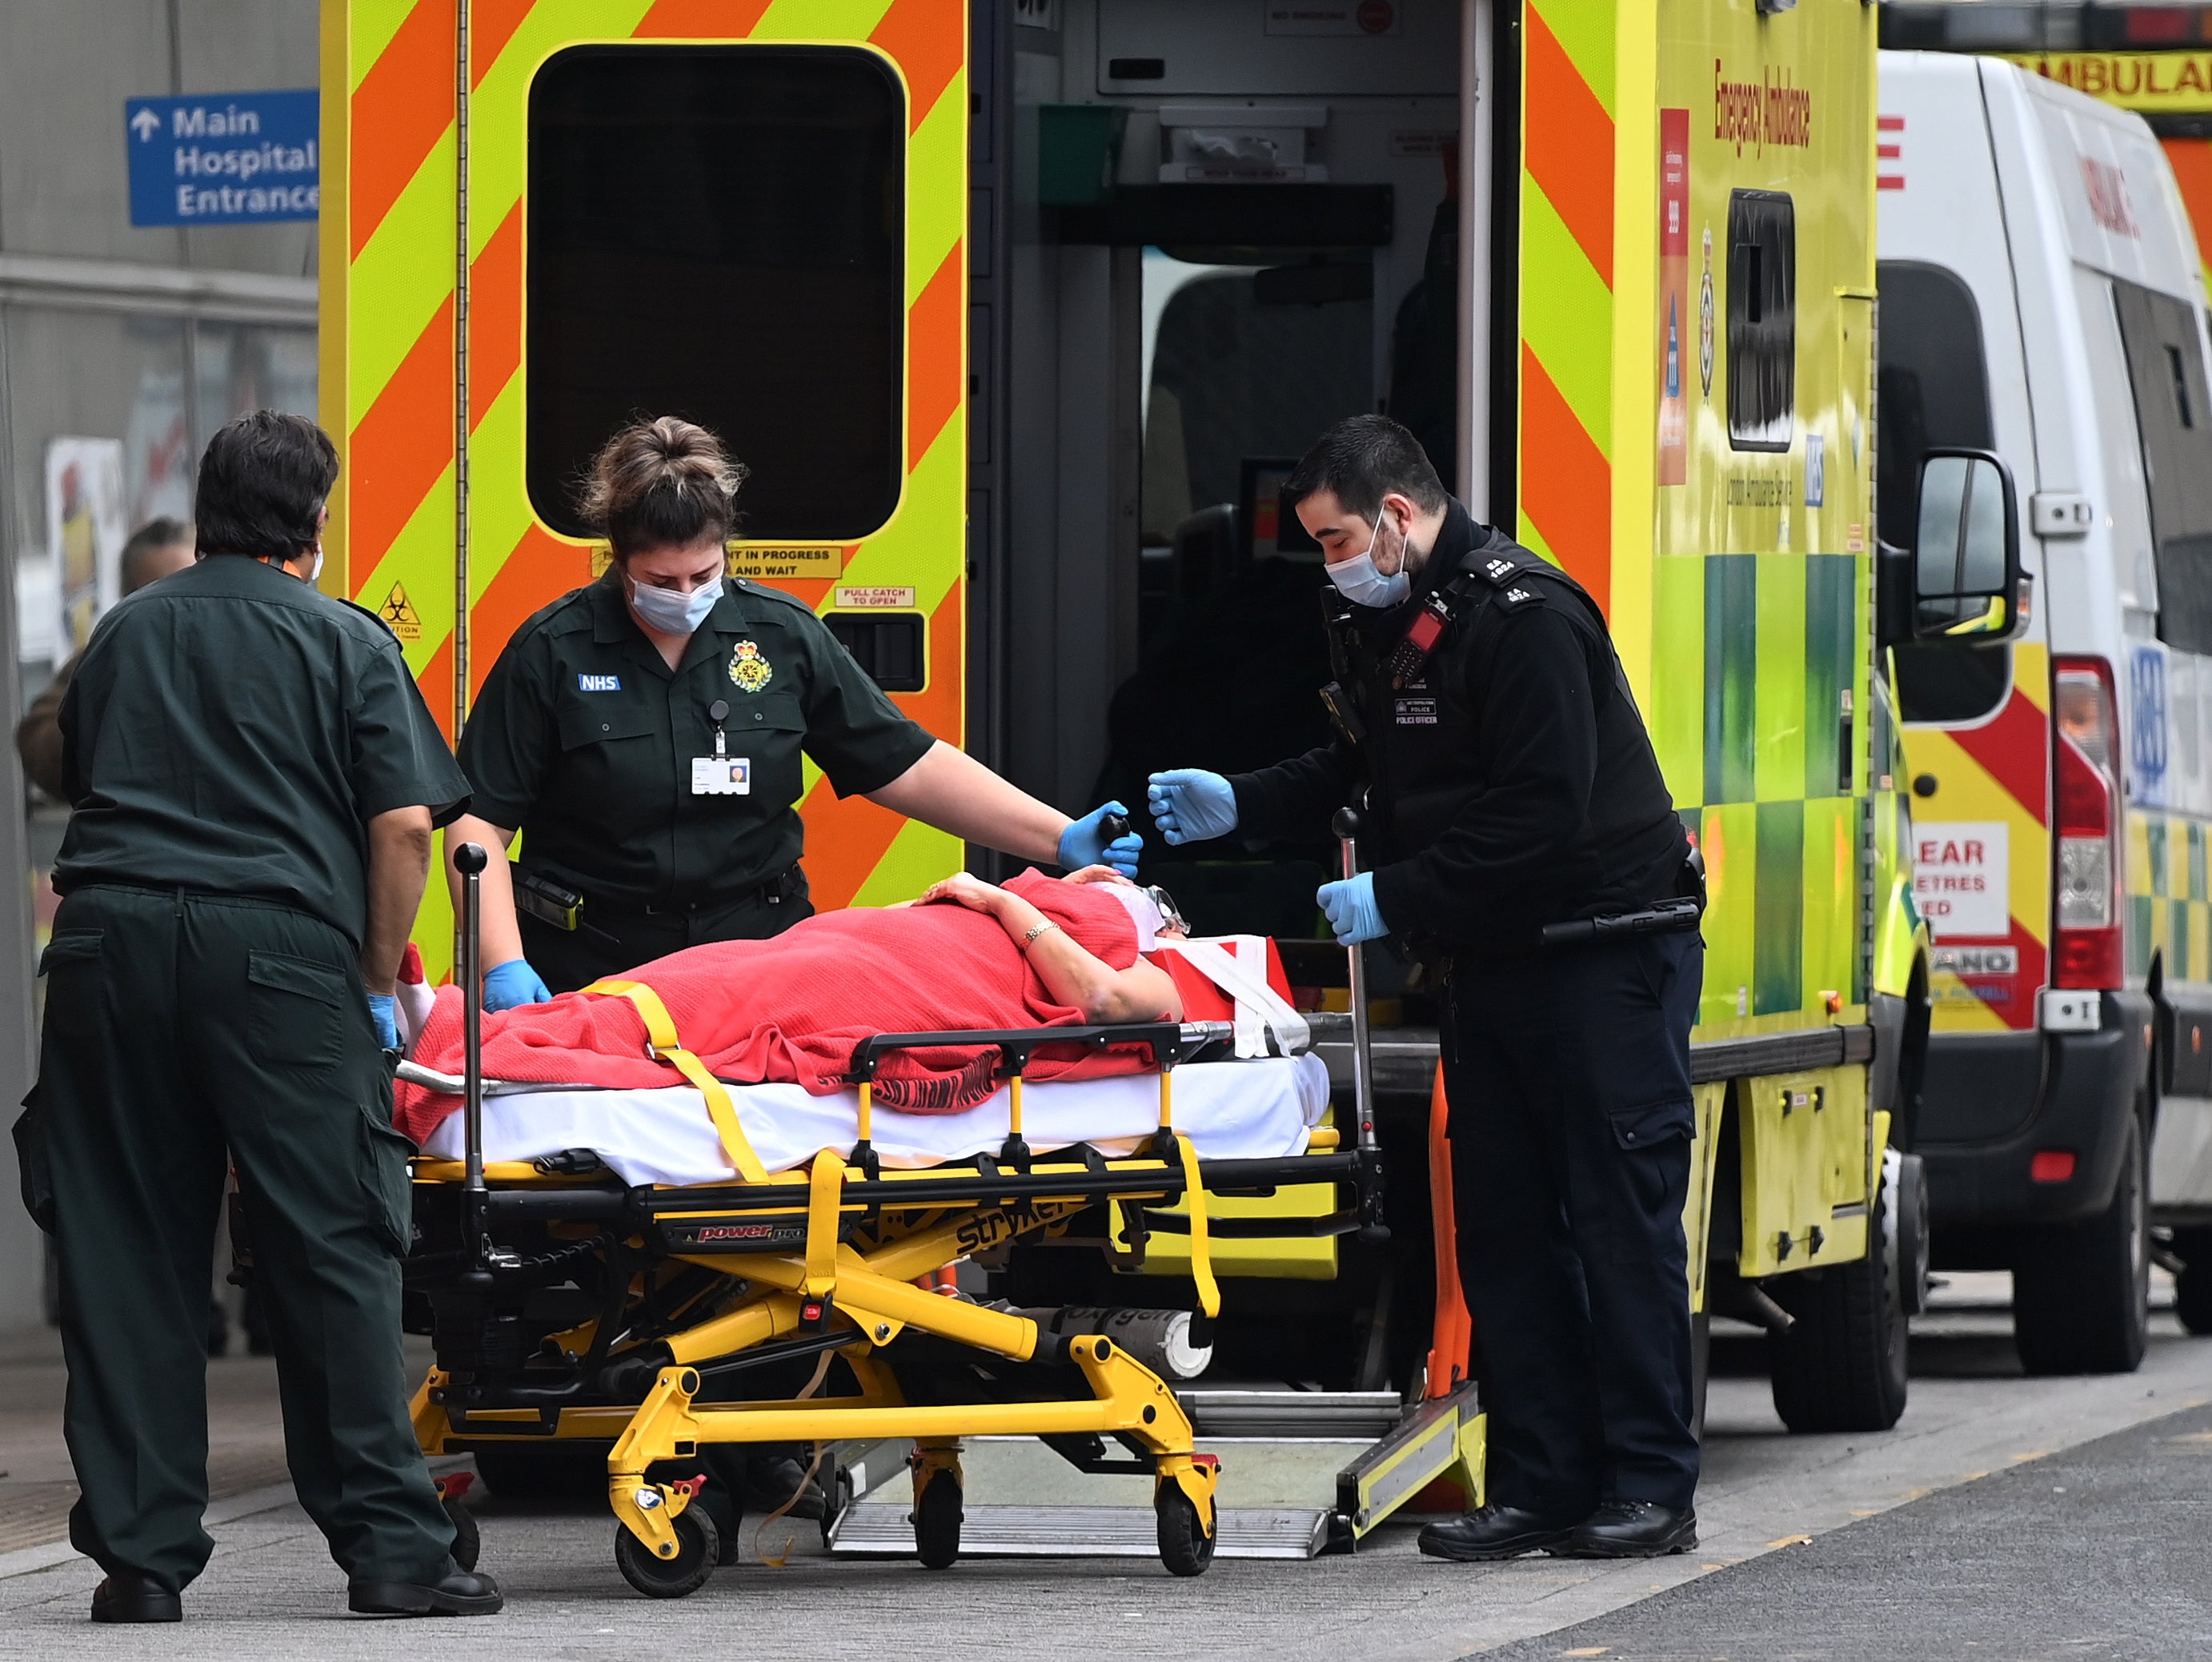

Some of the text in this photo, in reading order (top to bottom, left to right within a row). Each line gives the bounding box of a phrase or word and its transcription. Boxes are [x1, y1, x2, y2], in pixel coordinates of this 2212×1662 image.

[2016, 58, 2212, 95] MBULA
[1715, 58, 1810, 160] Emergency Ambulance
[173, 105, 259, 139] Main
[174, 140, 317, 181] Hospital
[746, 551, 759, 559] IN
[763, 551, 829, 559] PROGRESS
[735, 566, 797, 575] AND WAIT
[872, 588, 906, 596] CATCH
[870, 597, 897, 605] OPEN
[582, 676, 617, 691] NHS
[1396, 716, 1415, 724] POLICE
[1913, 840, 1983, 865] EAR
[698, 1224, 805, 1243] power pro
